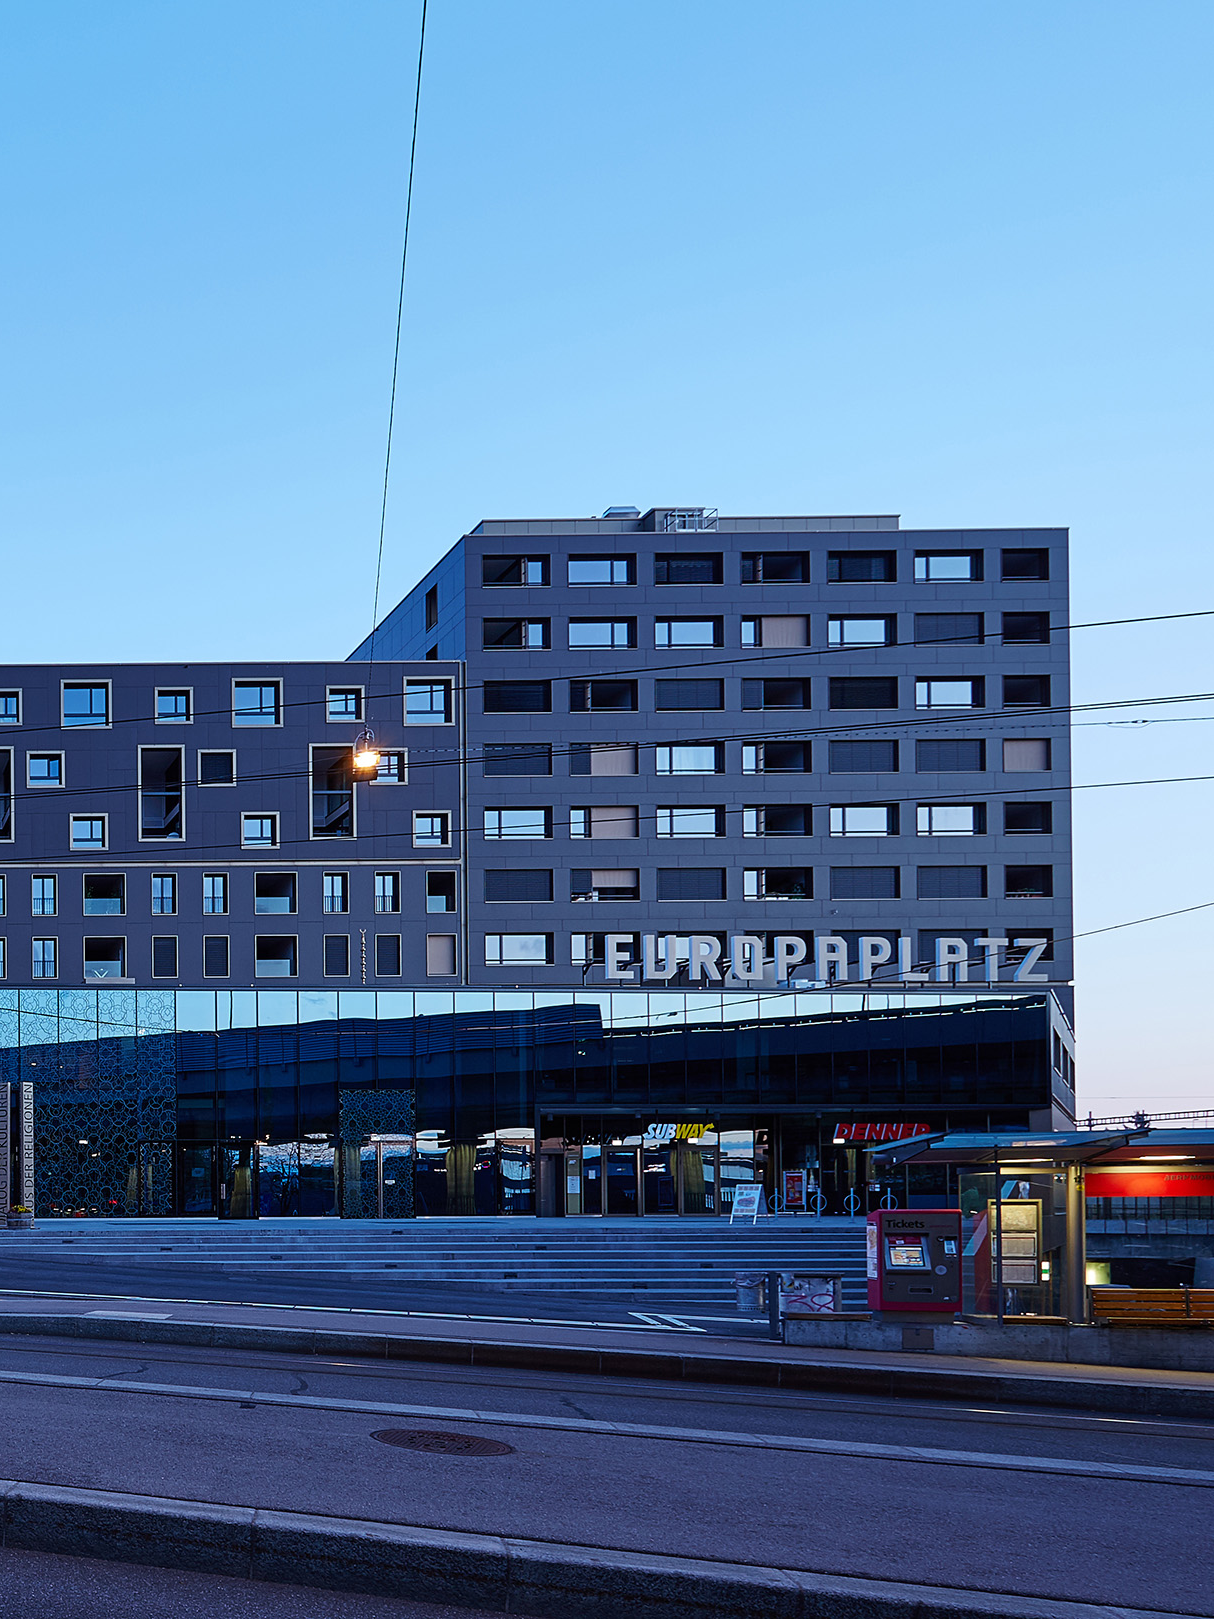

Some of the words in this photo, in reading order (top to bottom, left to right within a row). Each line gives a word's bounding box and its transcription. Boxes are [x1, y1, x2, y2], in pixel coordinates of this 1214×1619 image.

[604, 934, 1049, 982] EUROPAPLATZ
[24, 1084, 34, 1159] RELIGIONEN
[643, 1123, 714, 1139] SUBWAY
[833, 1123, 931, 1140] DENNER
[24, 1163, 34, 1188] DER
[886, 1220, 925, 1229] Tickets
